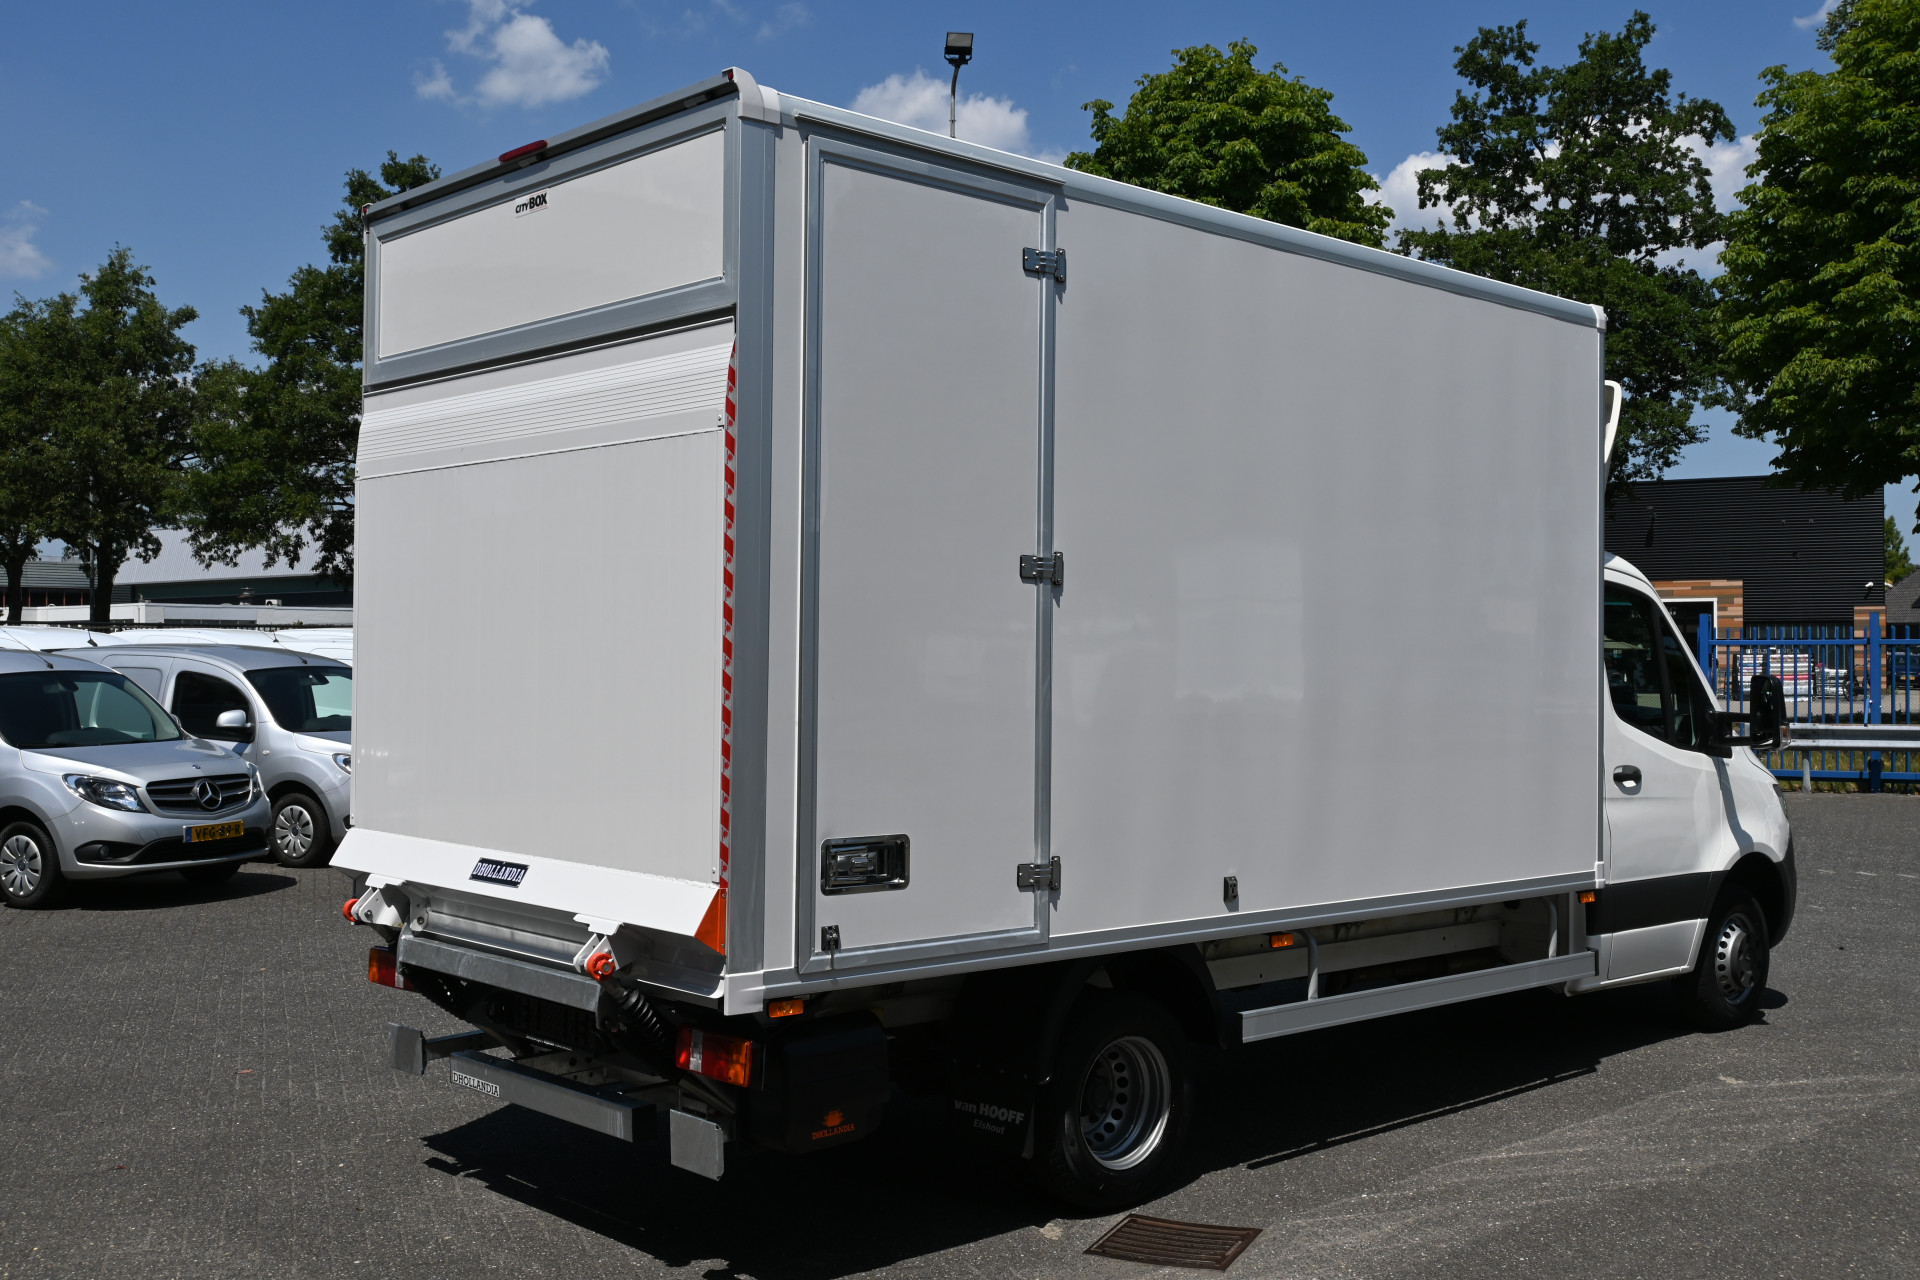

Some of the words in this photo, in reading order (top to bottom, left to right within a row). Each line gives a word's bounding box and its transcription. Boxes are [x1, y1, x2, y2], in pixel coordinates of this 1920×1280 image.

[472, 862, 526, 882] DHOLLANDIA
[453, 1072, 499, 1096] DHOLLANDIA
[979, 1102, 1025, 1125] HOOFF
[811, 1123, 855, 1140] DHOLLANDIA
[973, 1118, 1006, 1135] Elshout
